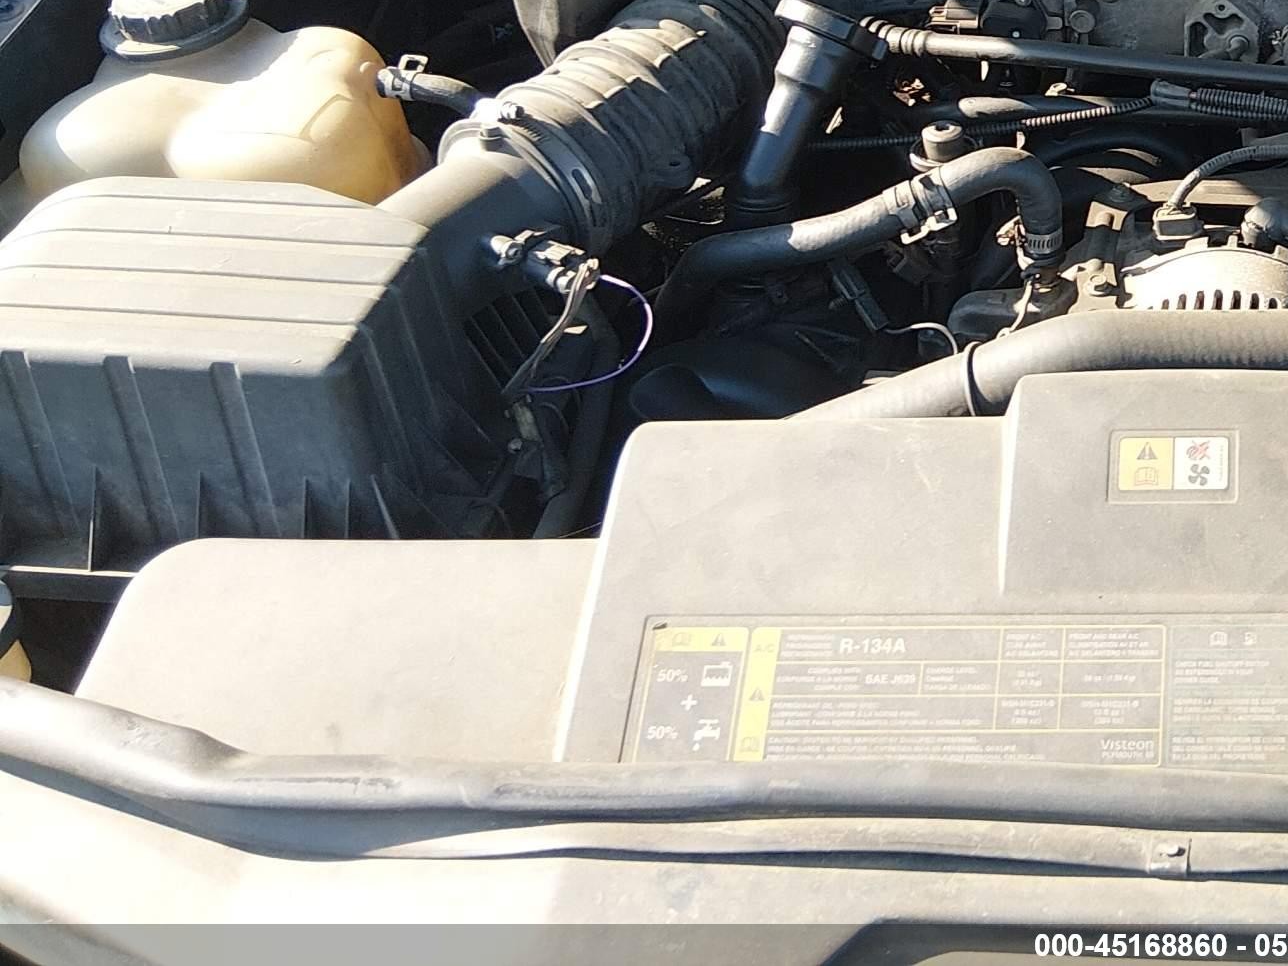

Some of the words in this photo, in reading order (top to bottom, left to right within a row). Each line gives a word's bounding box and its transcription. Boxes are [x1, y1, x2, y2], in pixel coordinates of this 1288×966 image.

[839, 638, 907, 655] R-134A
[656, 668, 688, 682] 50%
[647, 725, 679, 739] 50%
[1100, 738, 1155, 750] Visteon
